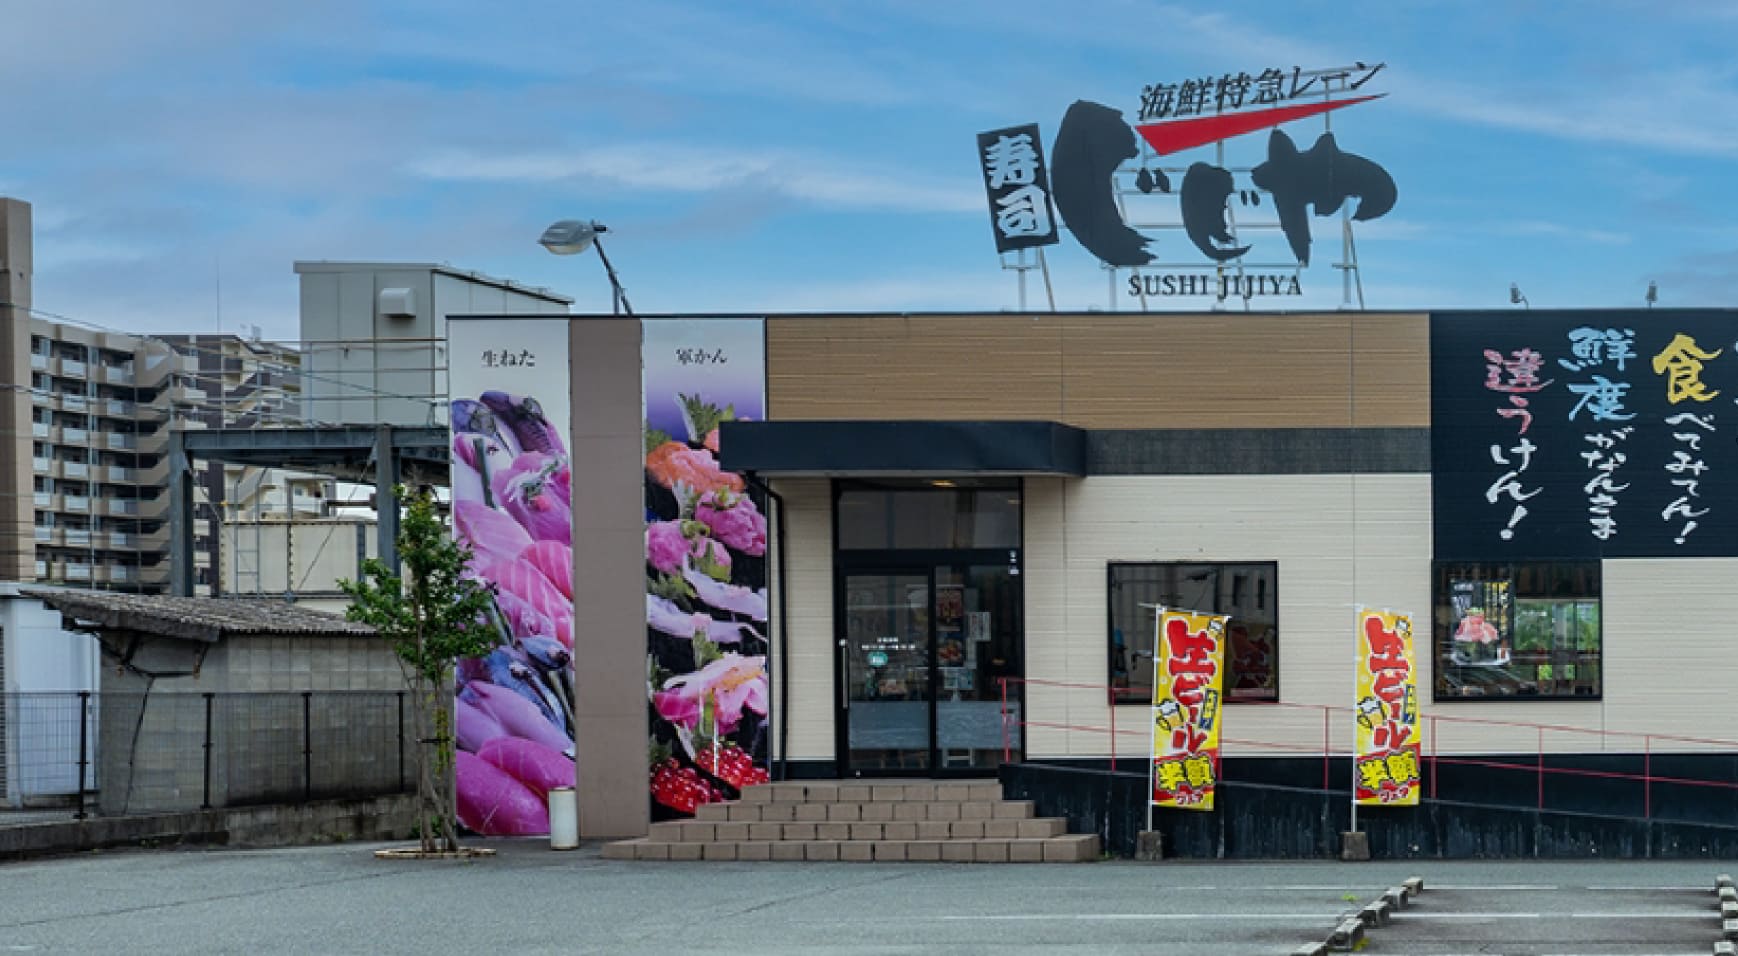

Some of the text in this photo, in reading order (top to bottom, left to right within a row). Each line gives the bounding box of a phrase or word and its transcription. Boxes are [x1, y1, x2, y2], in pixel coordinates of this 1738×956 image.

[1139, 61, 1386, 121] 海鮮特急レーン
[985, 132, 1051, 239] 寿司
[1050, 98, 1398, 268] じじや
[1129, 274, 1302, 300] SUSHI JIJIYA
[480, 349, 536, 368] 生ねた
[1557, 326, 1638, 541] 鮮度がなんさま
[1165, 617, 1217, 753] 生ビール
[1364, 616, 1413, 751] 生ビール
[1156, 753, 1215, 792] 半額
[1357, 749, 1420, 791] 半額
